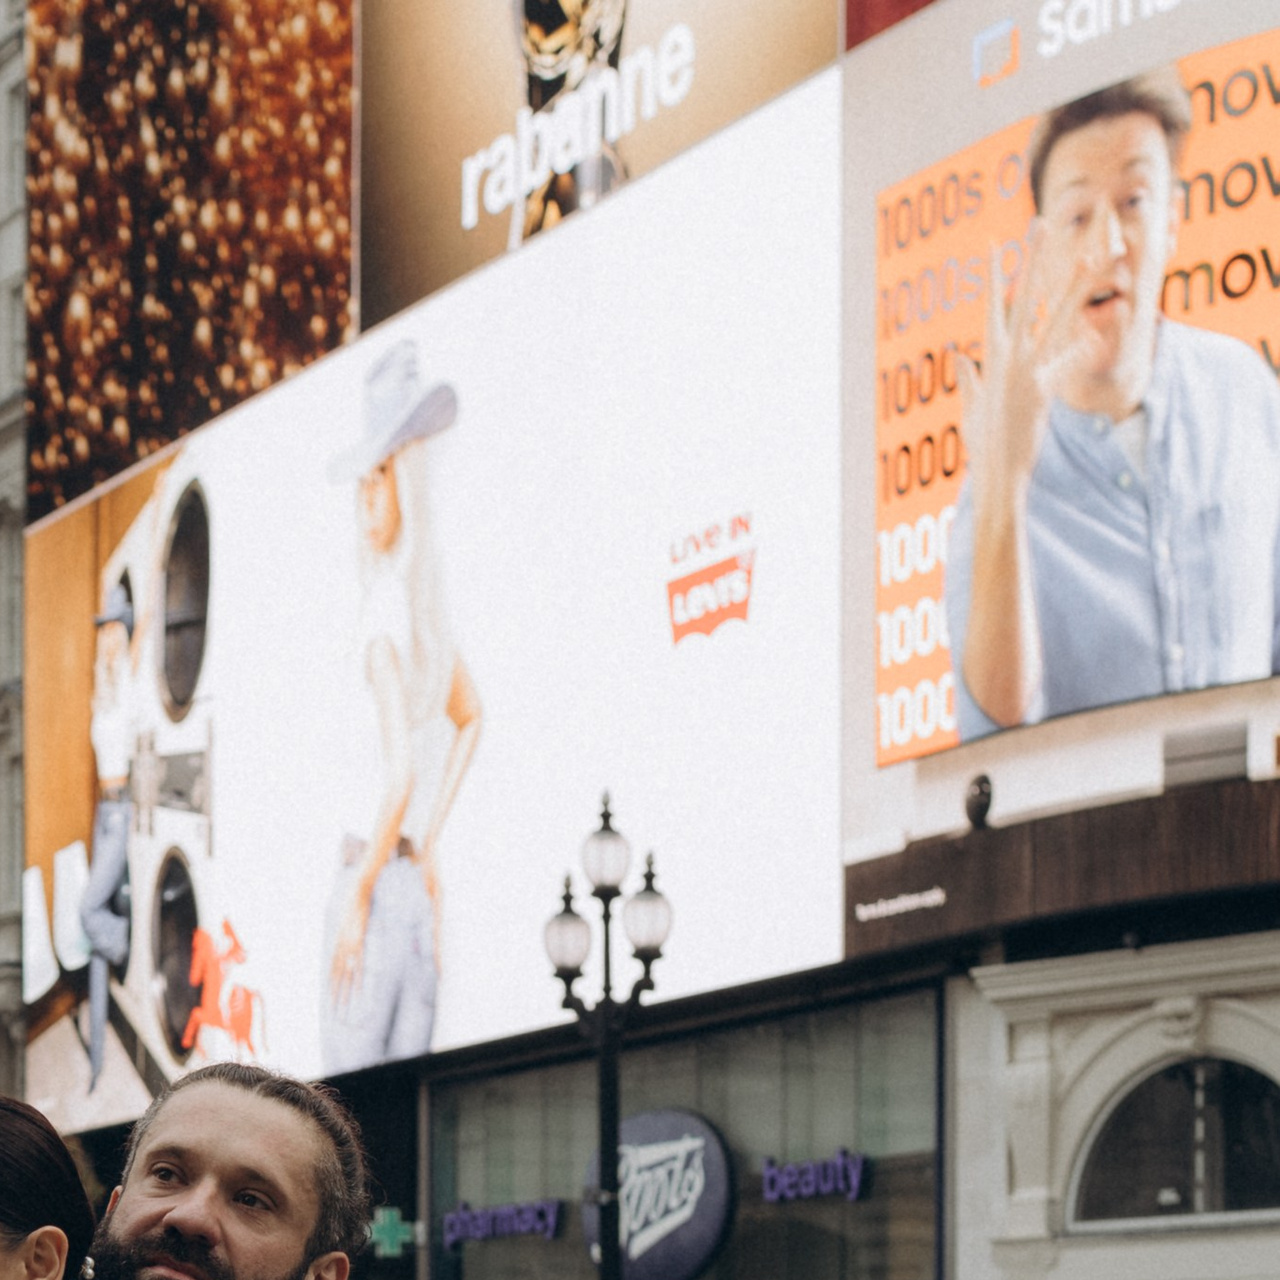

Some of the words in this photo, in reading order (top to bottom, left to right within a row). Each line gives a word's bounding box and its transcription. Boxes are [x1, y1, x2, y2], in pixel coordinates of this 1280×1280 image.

[461, 22, 697, 231] rabanne
[882, 424, 960, 504] 1000
[762, 1148, 865, 1201] beauty
[443, 1201, 561, 1251] pharmacy
